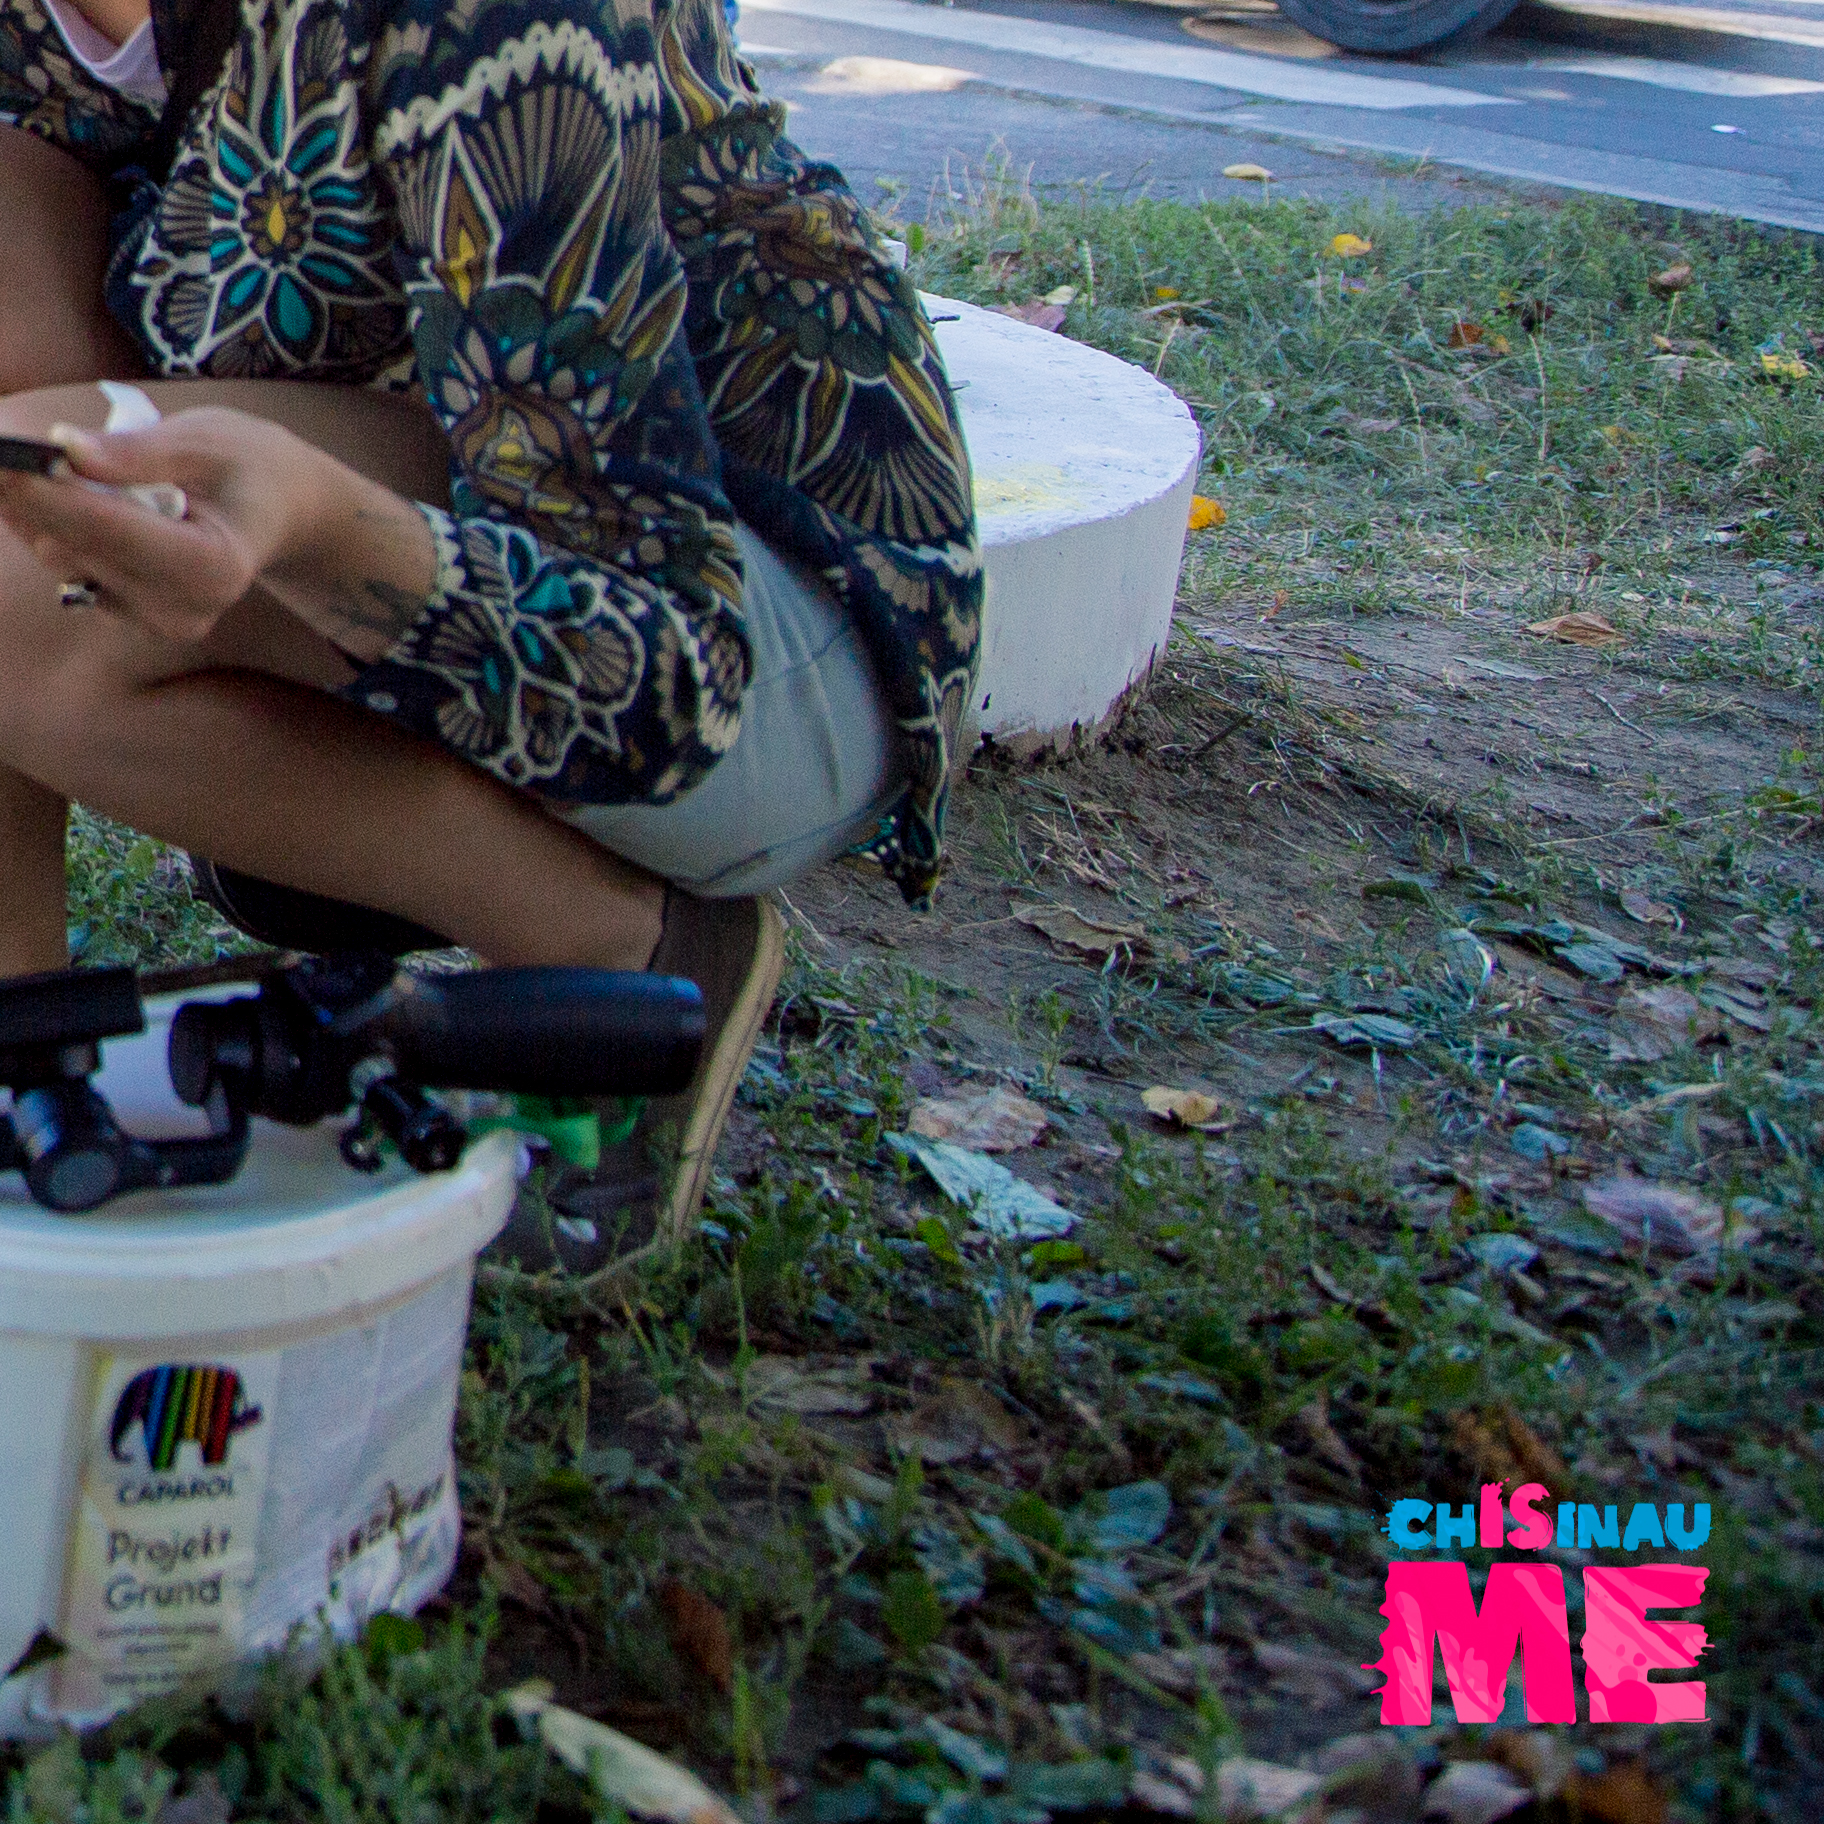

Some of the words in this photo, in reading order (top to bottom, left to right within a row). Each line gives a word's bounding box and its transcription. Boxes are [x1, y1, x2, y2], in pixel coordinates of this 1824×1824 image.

[116, 1474, 235, 1506] CAPAROL
[107, 1526, 233, 1574] Projekt
[103, 1569, 225, 1612] Grund
